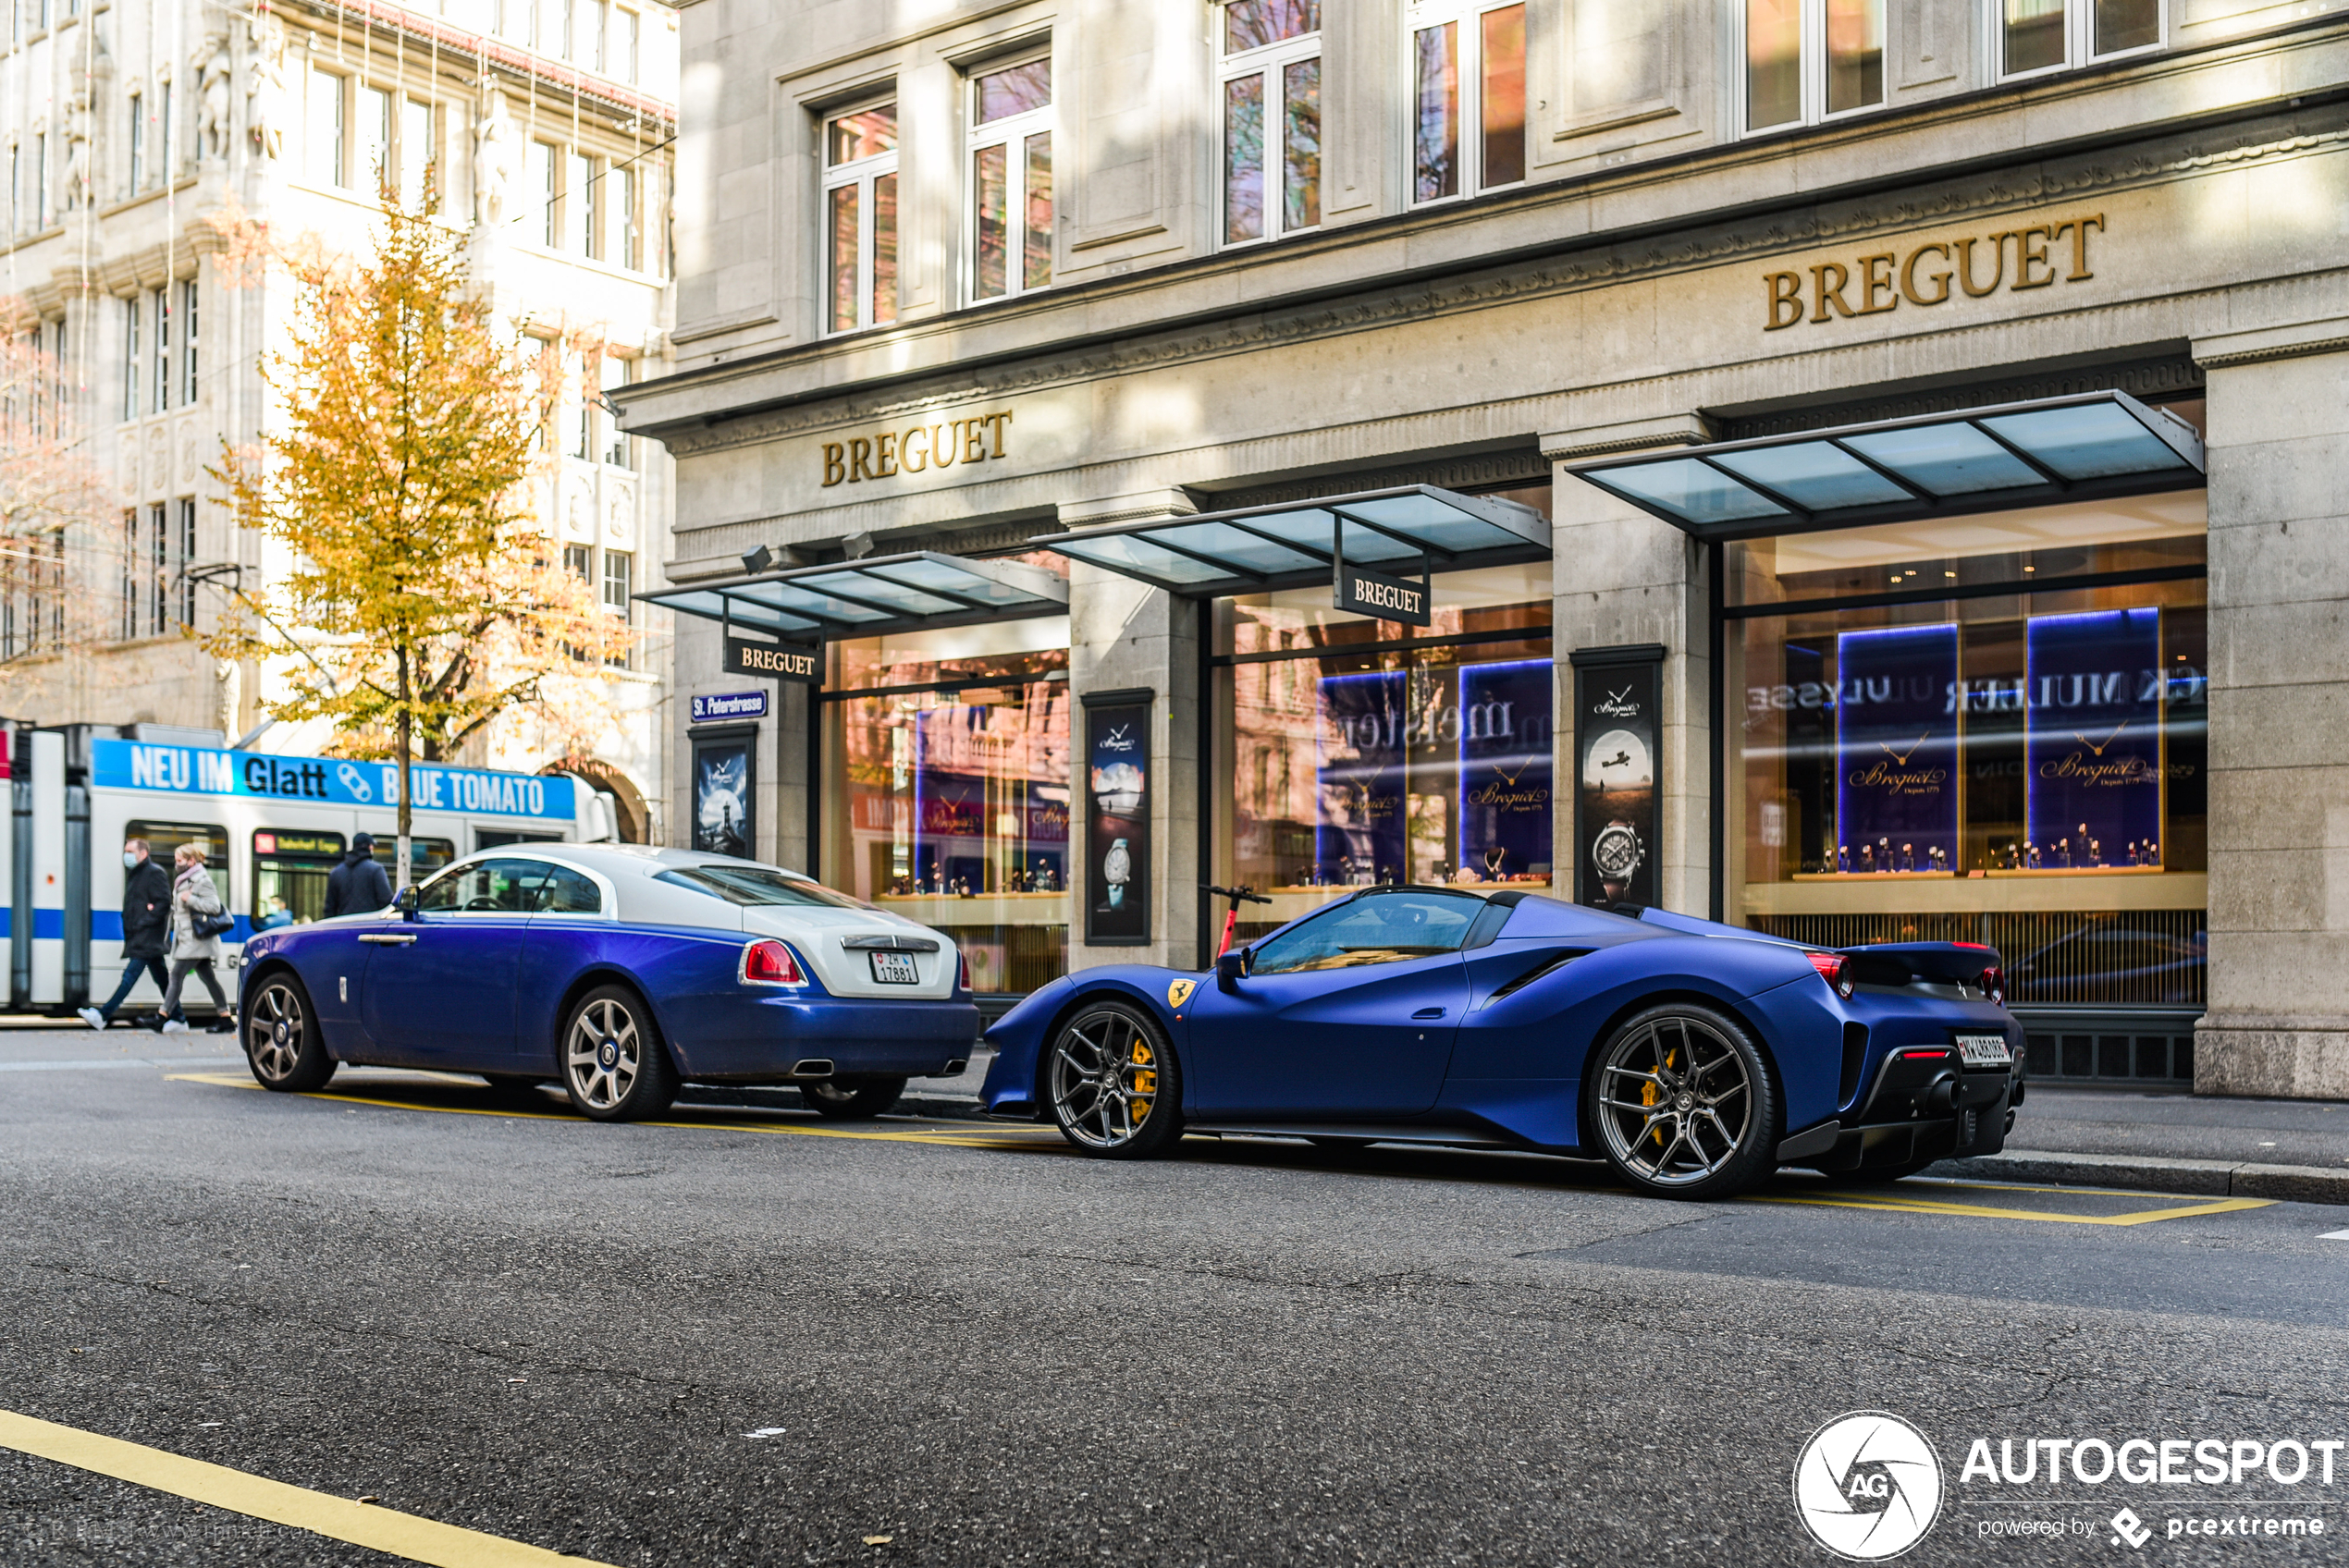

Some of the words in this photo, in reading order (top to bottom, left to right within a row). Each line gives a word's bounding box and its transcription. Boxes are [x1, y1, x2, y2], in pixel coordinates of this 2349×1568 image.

[1764, 213, 2104, 331] BREGUET
[821, 409, 1013, 487] BREGUET
[1355, 579, 1421, 613] BREGUET
[742, 647, 815, 676] BREGUET
[694, 699, 706, 717] St.
[707, 696, 762, 715] Peterstrasse
[130, 745, 190, 790] NEU
[197, 750, 233, 793] IM
[244, 757, 327, 798] Glatt
[382, 766, 444, 808] BUE
[449, 771, 545, 815] TOMATO
[1850, 761, 1947, 796] Breguet
[2040, 752, 2146, 787] Breguet
[1468, 782, 1548, 813] Breguet
[880, 966, 913, 982] 17881
[888, 953, 900, 965] ZH
